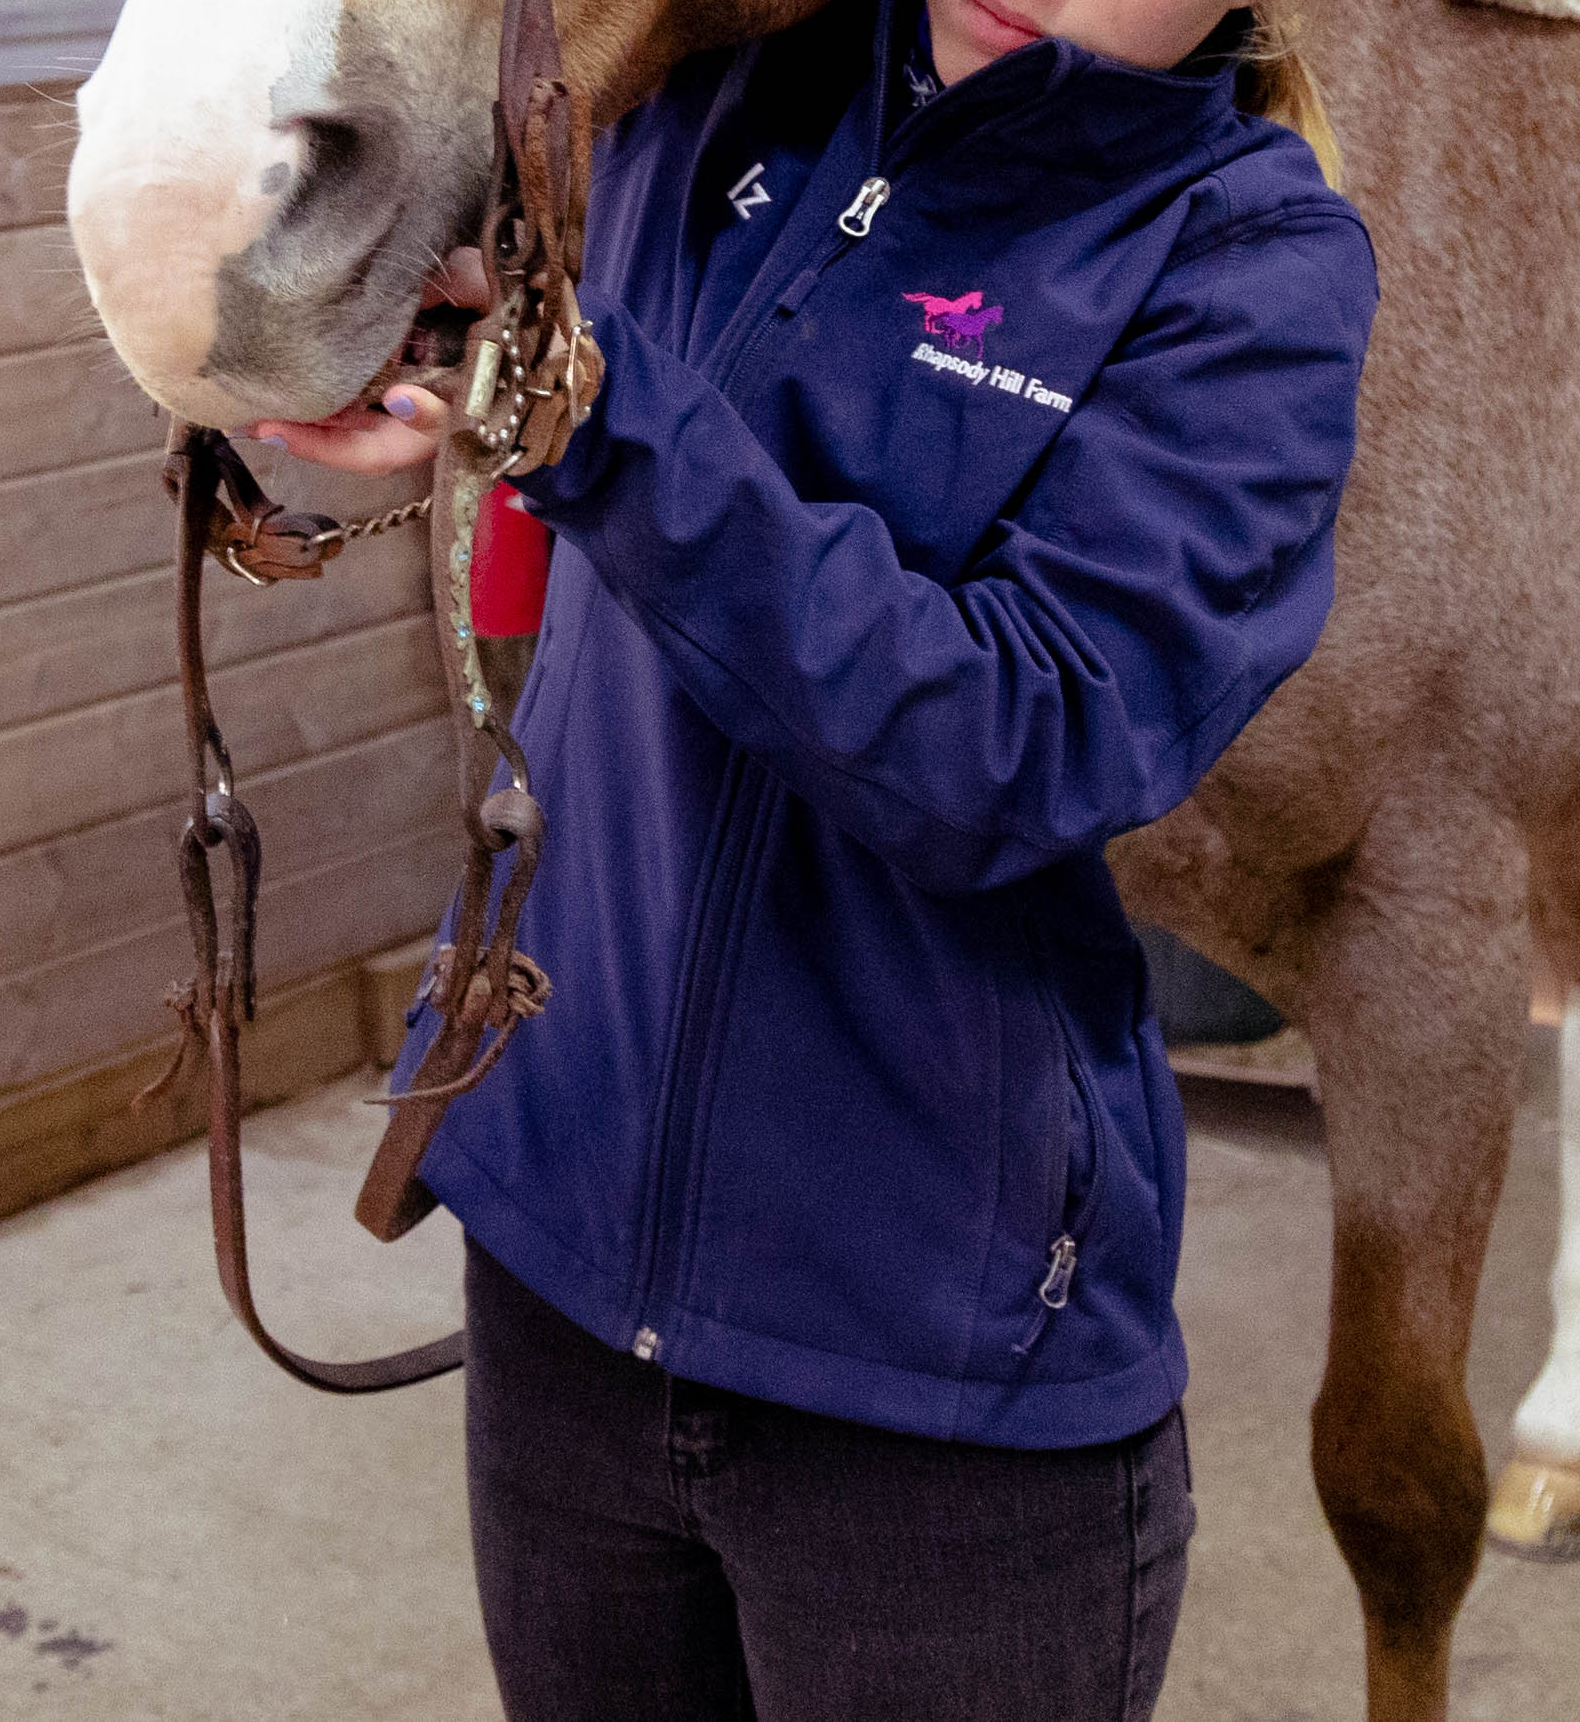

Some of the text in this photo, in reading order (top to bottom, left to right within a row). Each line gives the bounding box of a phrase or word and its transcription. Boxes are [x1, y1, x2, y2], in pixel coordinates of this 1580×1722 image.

[911, 342, 1073, 413] Rhapsody Hill Farm
